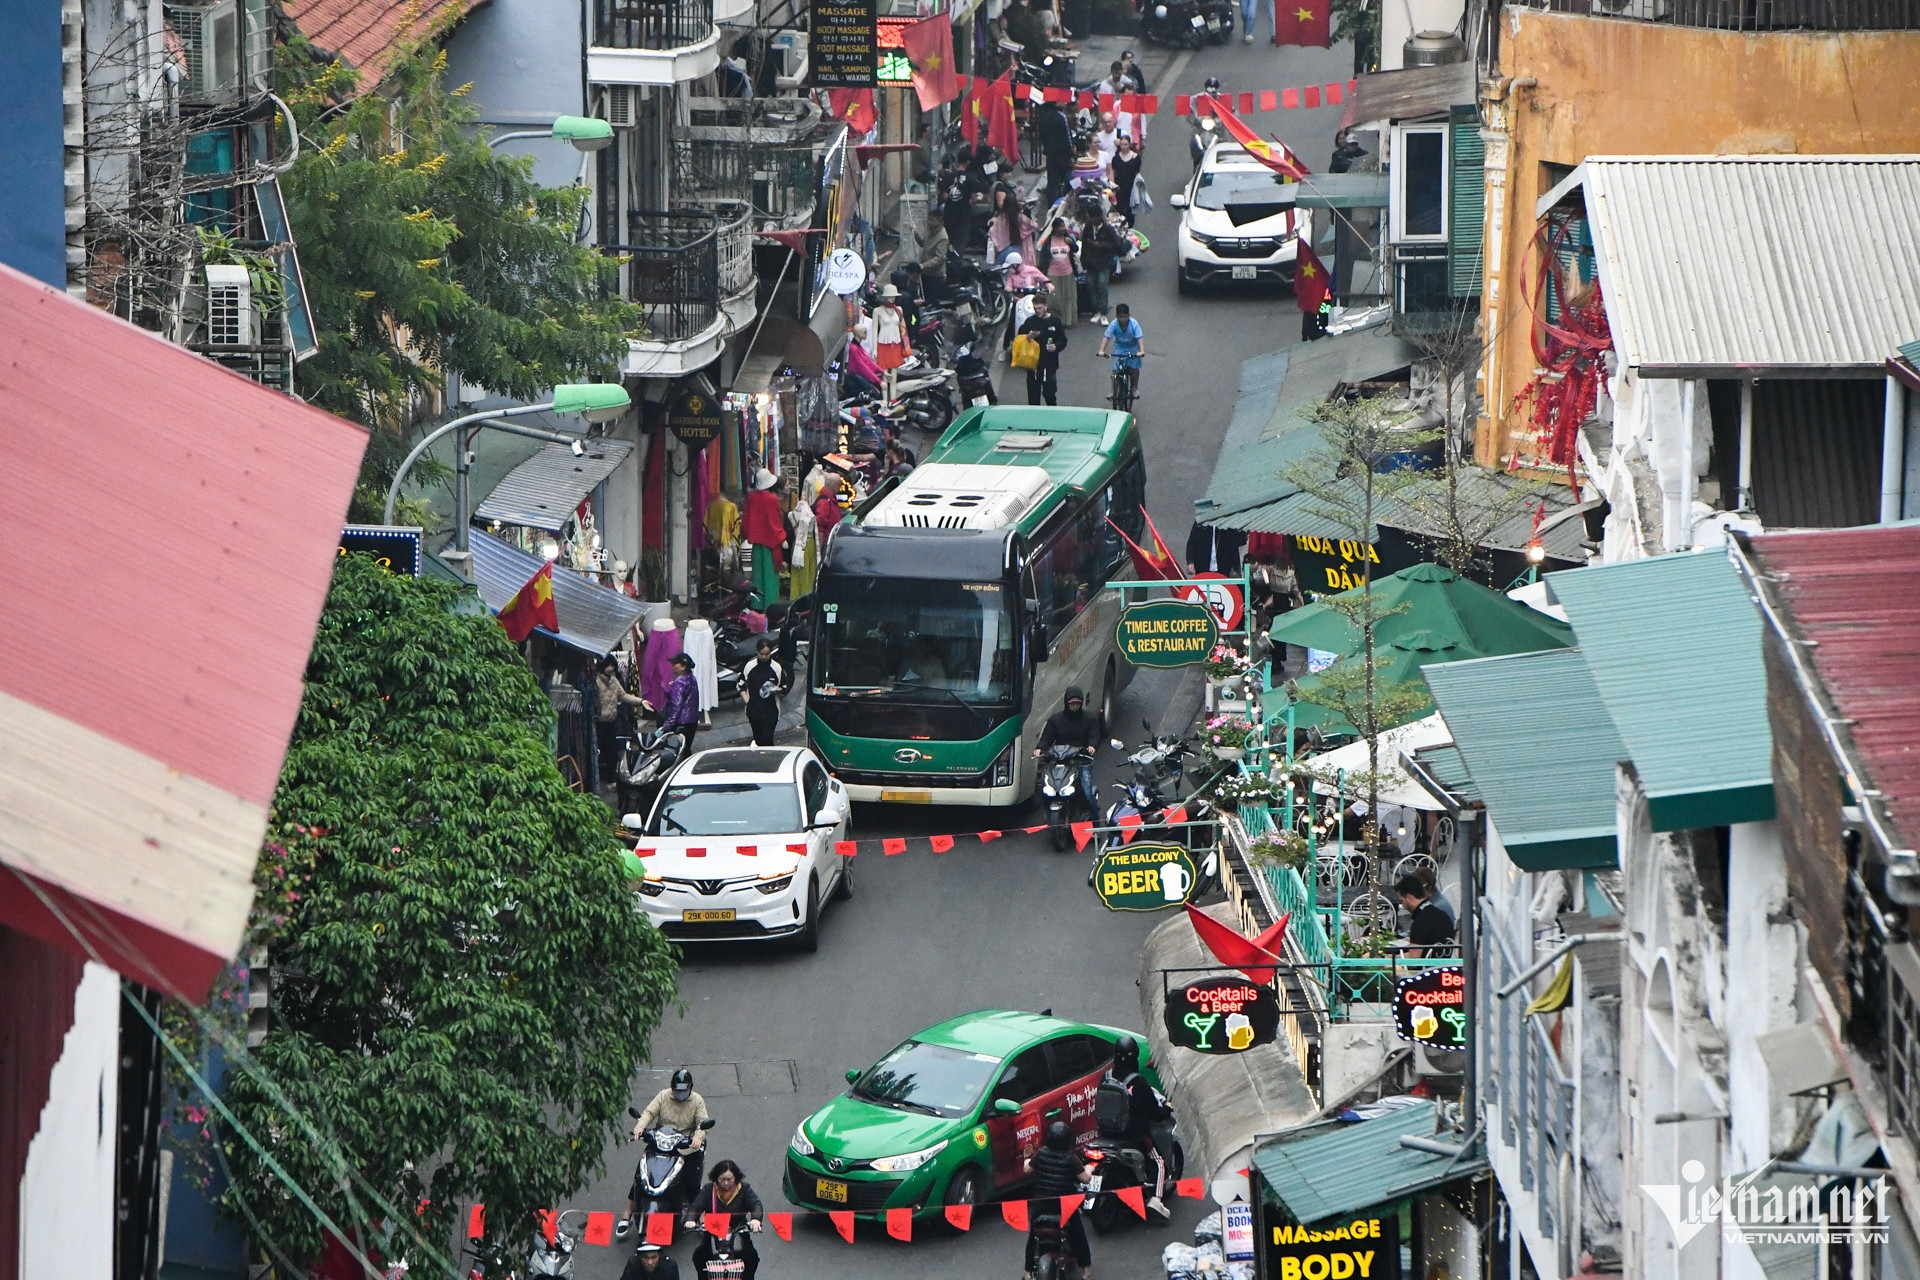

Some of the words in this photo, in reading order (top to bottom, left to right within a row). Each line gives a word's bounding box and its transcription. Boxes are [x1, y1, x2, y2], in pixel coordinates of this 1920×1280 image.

[818, 8, 867, 16] MASSAGE
[817, 26, 836, 34] BODY
[817, 45, 835, 53] FOOT
[836, 45, 870, 53] MASSAGE
[680, 427, 712, 437] HOTEL
[1125, 620, 1169, 634] TIMELINE
[1170, 619, 1208, 633] COFFEE
[1127, 639, 1136, 653] &
[1137, 637, 1206, 652] RESTAURANT
[1109, 855, 1130, 866] THE
[1131, 851, 1179, 864] BALCONY
[1103, 869, 1160, 896] BEER
[1186, 986, 1258, 1002] Cocktails
[1200, 1003, 1210, 1013] &
[1212, 1002, 1244, 1012] Beer
[825, 1182, 839, 1192] 29E
[1272, 1219, 1381, 1246] MASSAGE
[1281, 1250, 1375, 1280] BODY
